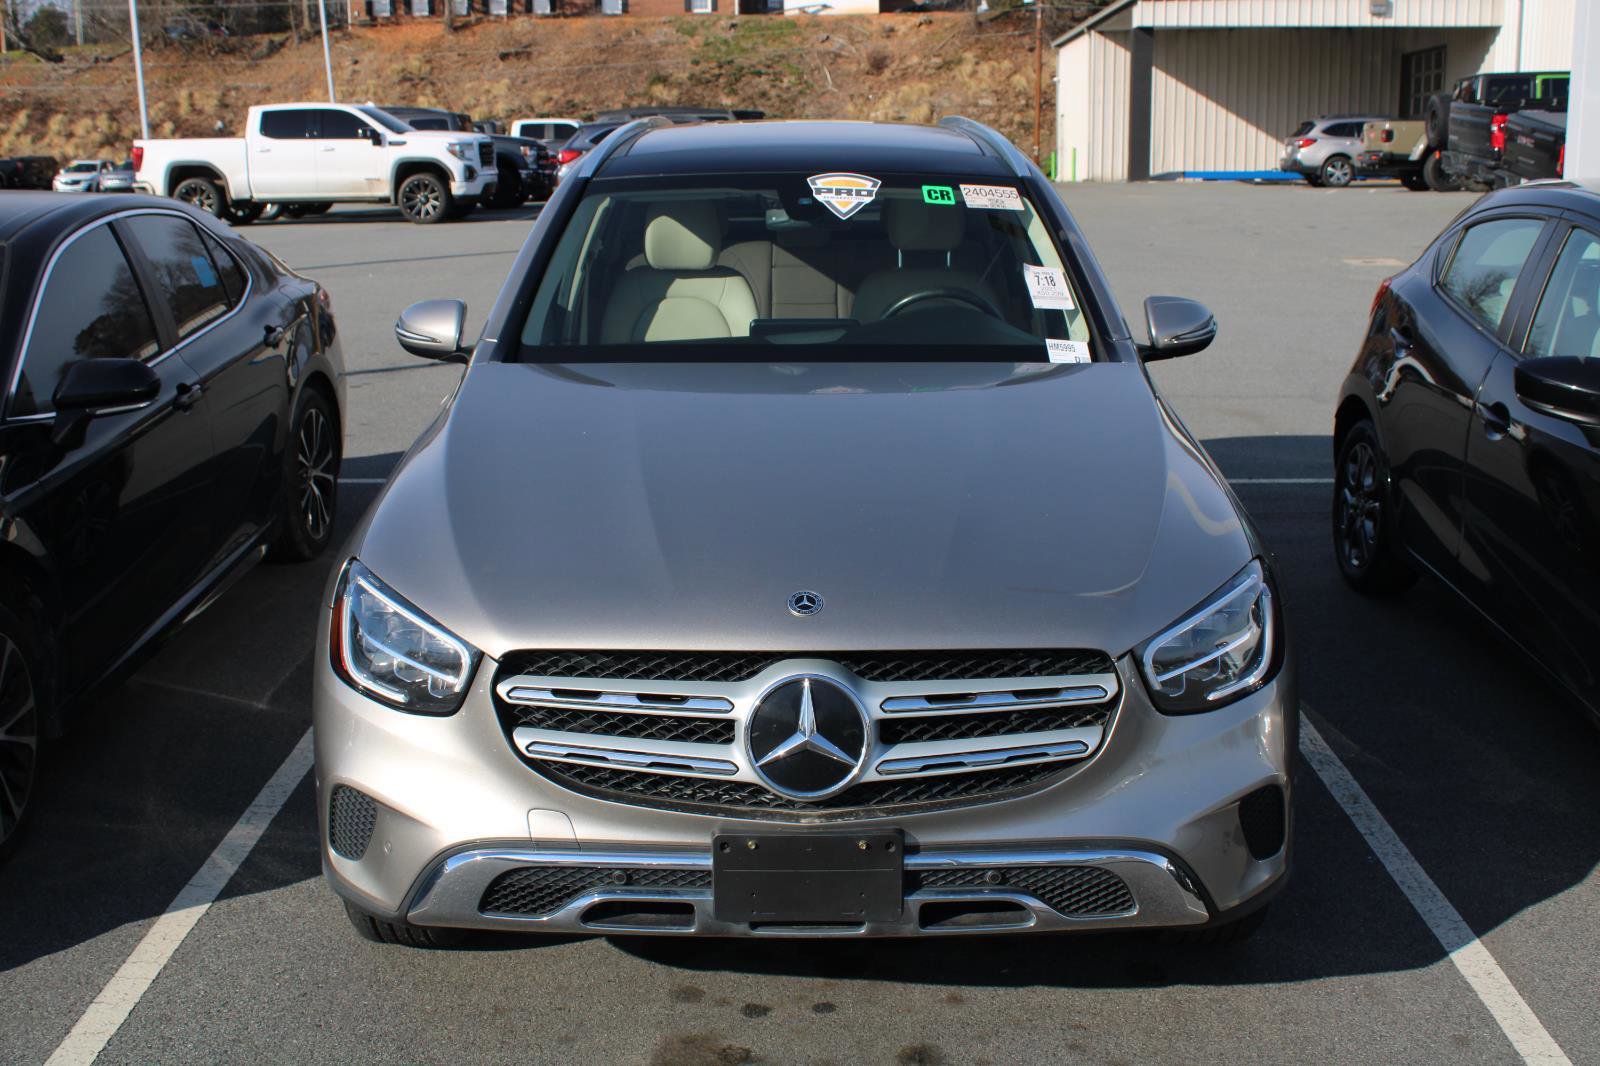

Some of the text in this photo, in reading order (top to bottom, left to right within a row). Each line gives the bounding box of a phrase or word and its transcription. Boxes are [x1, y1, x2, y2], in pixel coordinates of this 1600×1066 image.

[814, 187, 874, 198] PRO
[926, 188, 952, 201] CR
[963, 187, 1019, 199] 2404555
